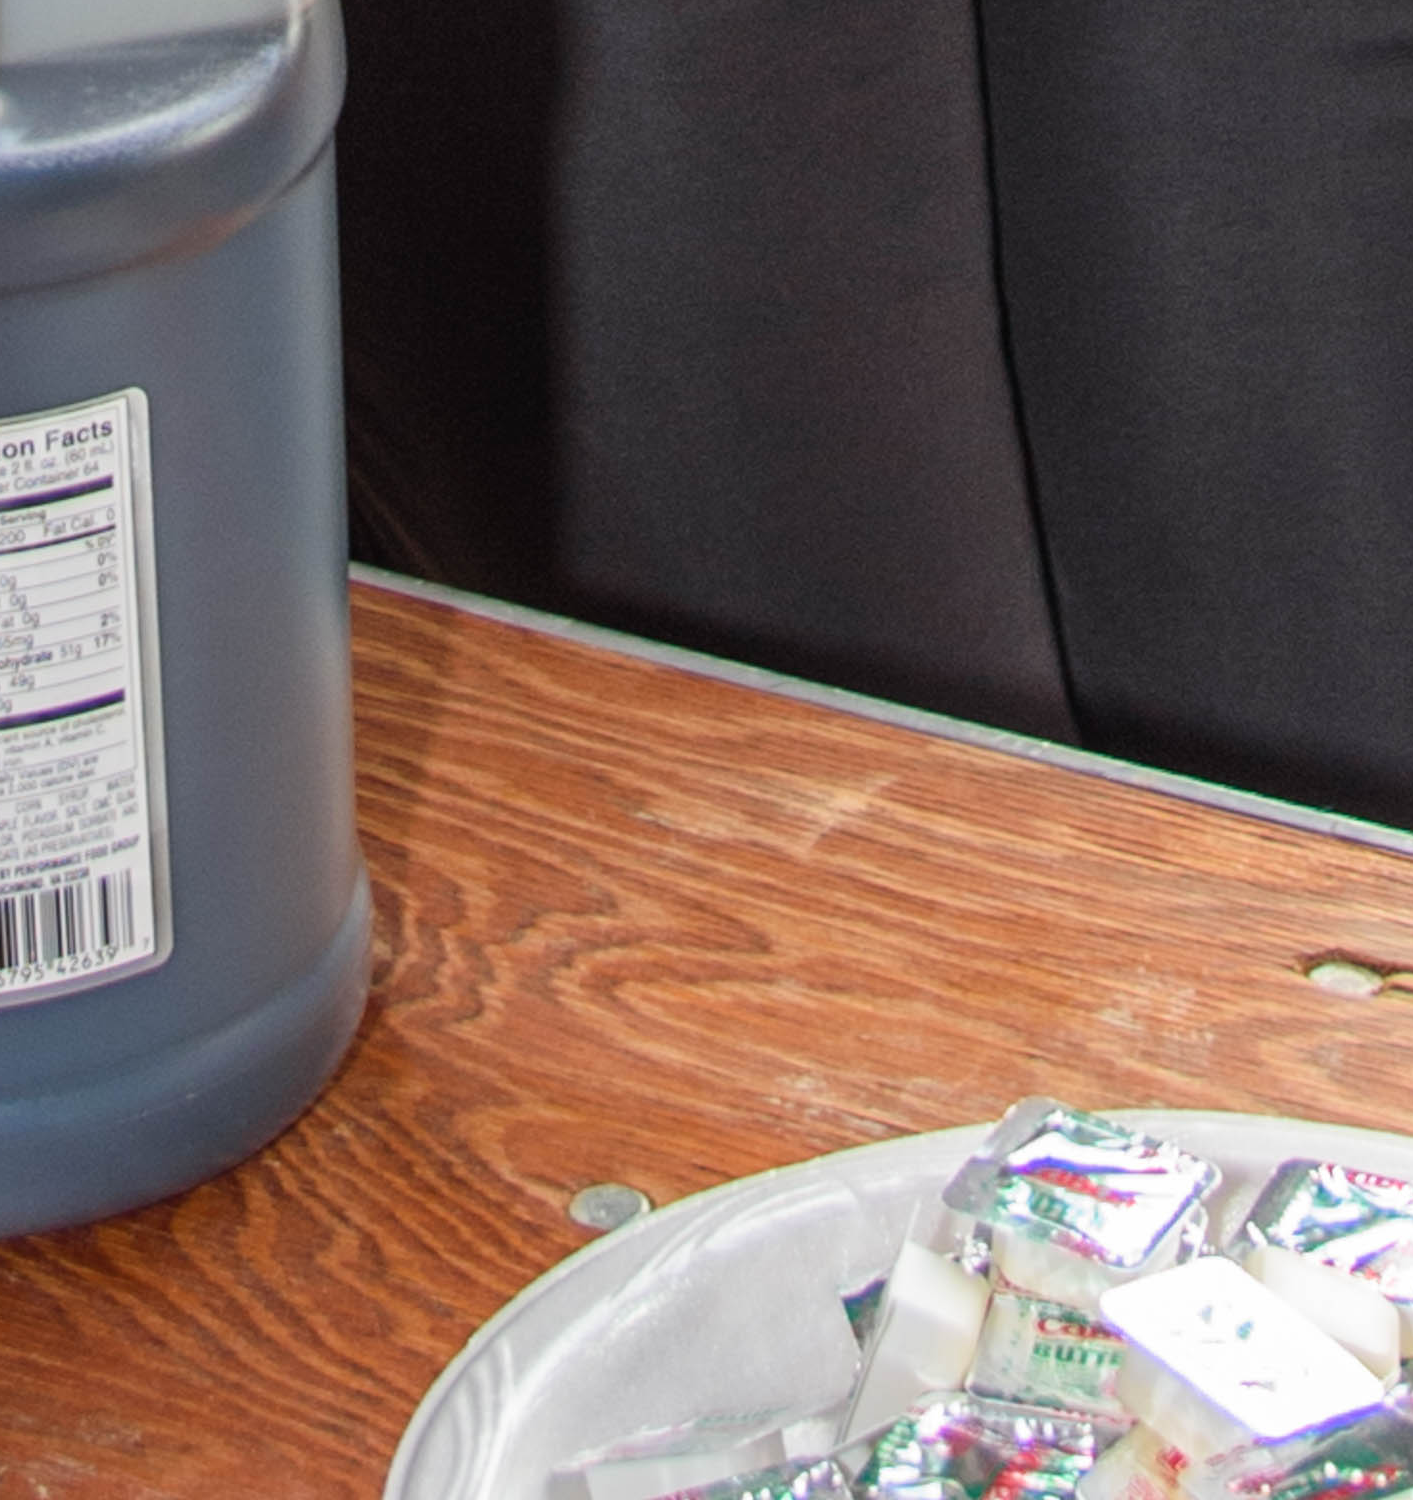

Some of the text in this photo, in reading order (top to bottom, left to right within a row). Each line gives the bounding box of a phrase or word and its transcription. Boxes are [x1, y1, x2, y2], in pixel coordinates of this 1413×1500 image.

[45, 420, 113, 451] Facts
[13, 467, 80, 491] Container
[43, 521, 67, 538] Fat
